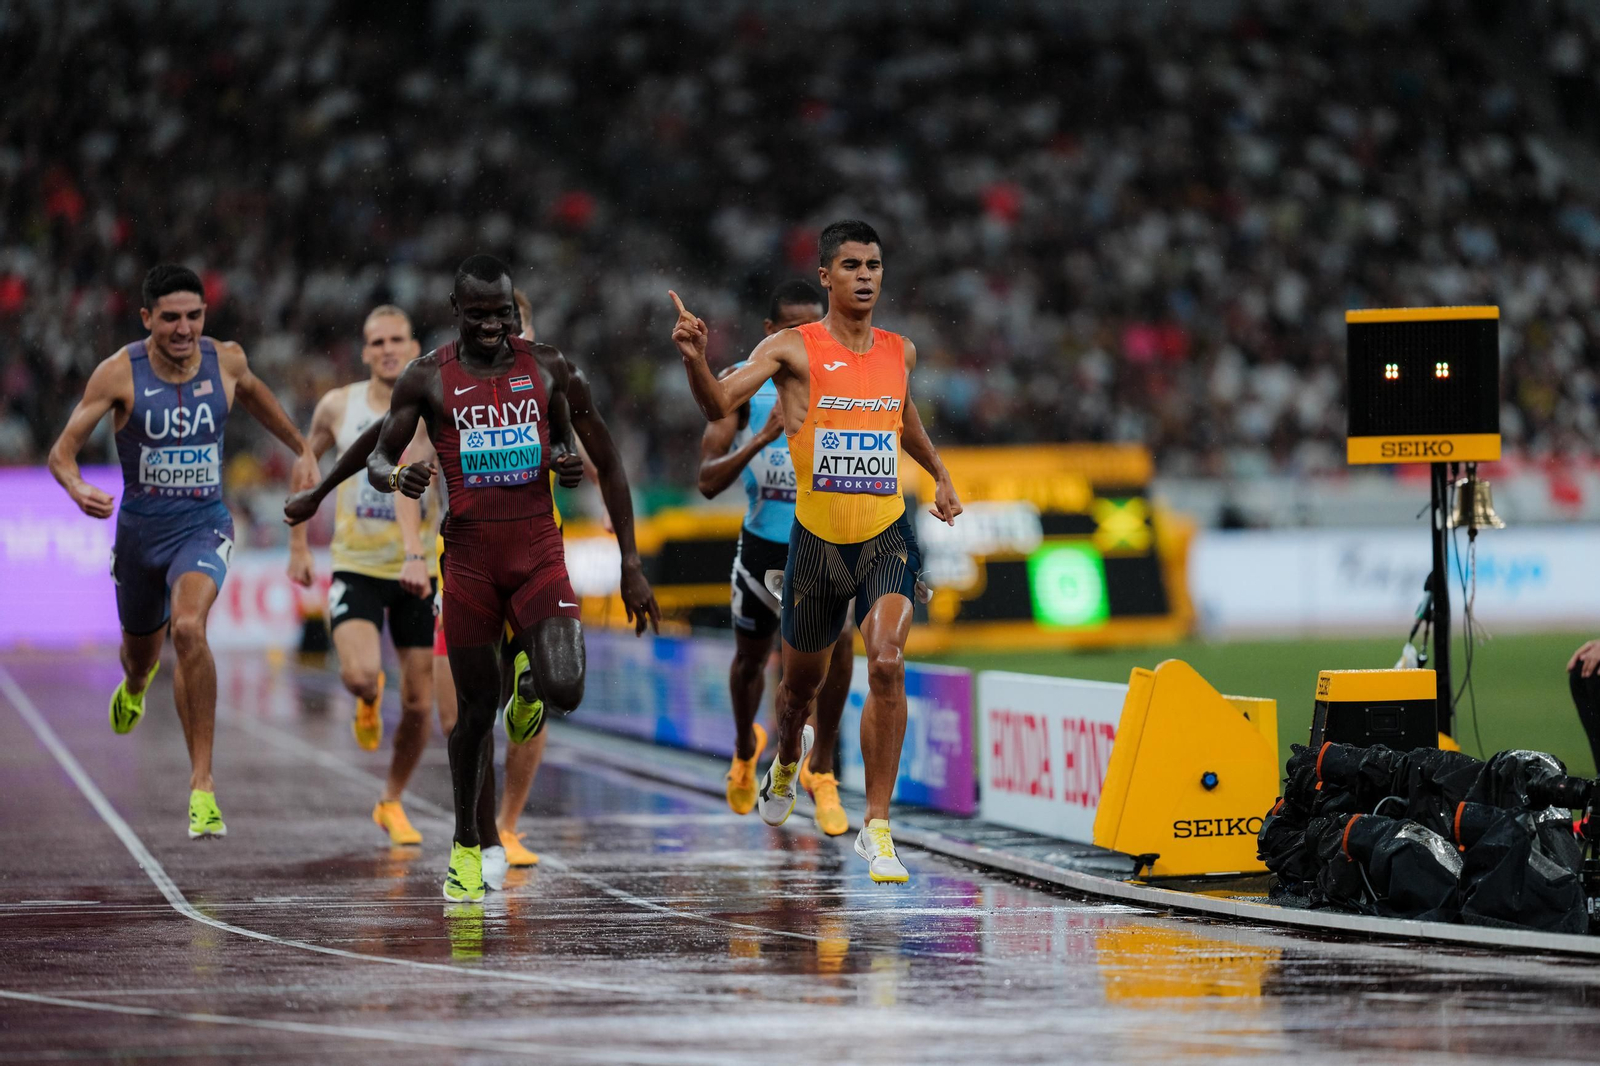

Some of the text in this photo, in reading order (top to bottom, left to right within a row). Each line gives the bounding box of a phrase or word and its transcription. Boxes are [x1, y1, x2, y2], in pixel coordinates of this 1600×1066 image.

[816, 395, 902, 413] ESPAÑA
[144, 402, 216, 440] USA
[452, 398, 541, 431] KENYA
[484, 425, 535, 447] TDK
[839, 432, 893, 452] TDK
[162, 447, 212, 465] TDK
[464, 446, 539, 472] WANYONYI
[1380, 440, 1454, 458] SEIKO
[817, 455, 895, 476] ATTAOUI
[144, 467, 214, 485] HOPPEL
[765, 469, 797, 487] MAS
[835, 480, 896, 491] TOKYO 25
[1173, 816, 1264, 839] SEIKO
